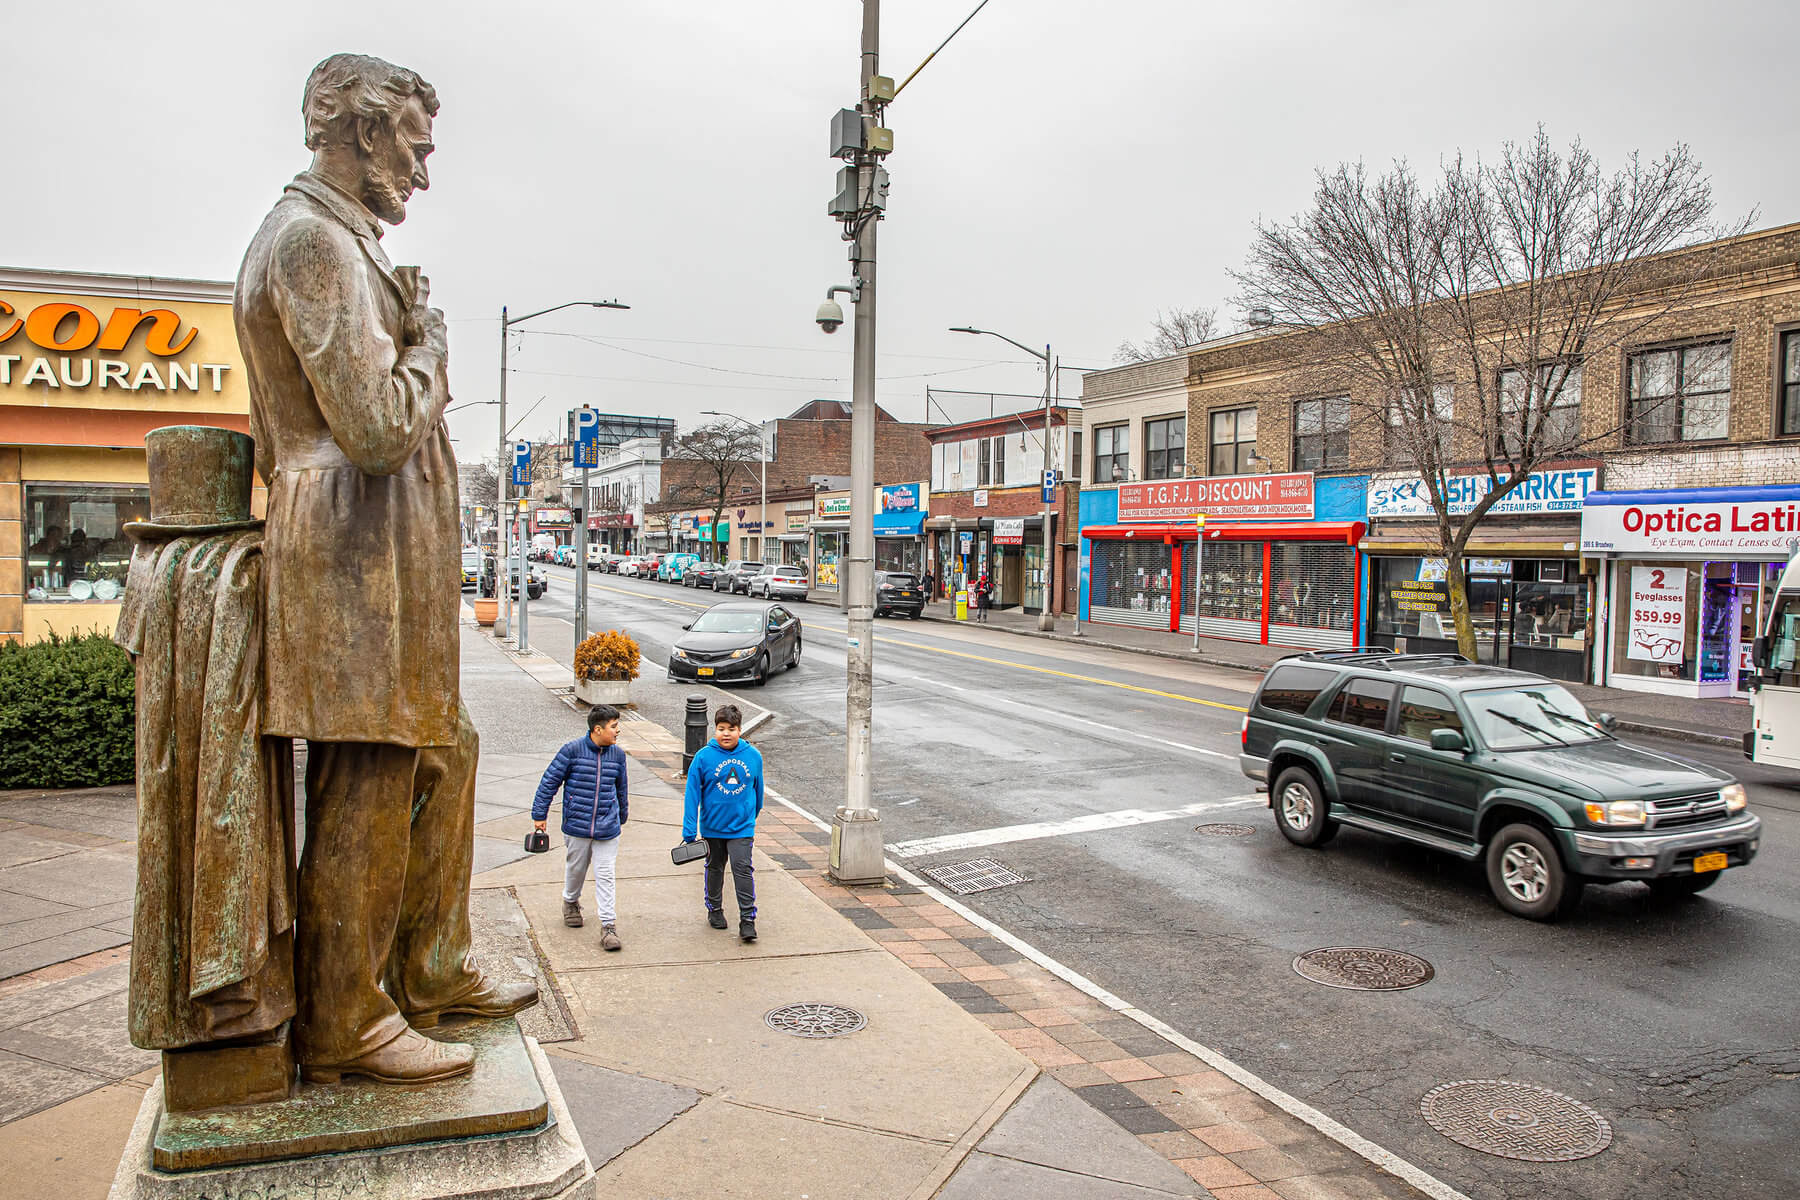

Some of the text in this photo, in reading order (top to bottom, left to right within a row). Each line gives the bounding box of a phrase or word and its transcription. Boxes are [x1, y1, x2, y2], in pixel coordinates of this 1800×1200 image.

[574, 408, 597, 441] P
[512, 442, 530, 466] P
[1147, 480, 1272, 504] T.G.F.J. DISCOUNT
[1373, 480, 1420, 505] SKY
[1500, 503, 1524, 512] STEAM
[1527, 502, 1542, 511] FISH
[1623, 505, 1800, 536] Optica Lati
[1651, 537, 1667, 549] Eye
[1670, 537, 1696, 548] Exam,
[1699, 537, 1733, 547] Contact
[1737, 538, 1769, 547] Lenses
[1650, 569, 1664, 589] 2
[1391, 591, 1446, 601] STEAMED SEAFOOD
[1634, 592, 1683, 602] Eyeglasses
[1411, 602, 1437, 611] CHICKEN
[1634, 609, 1682, 624] $59.99
[716, 782, 746, 796] NEW YORK
